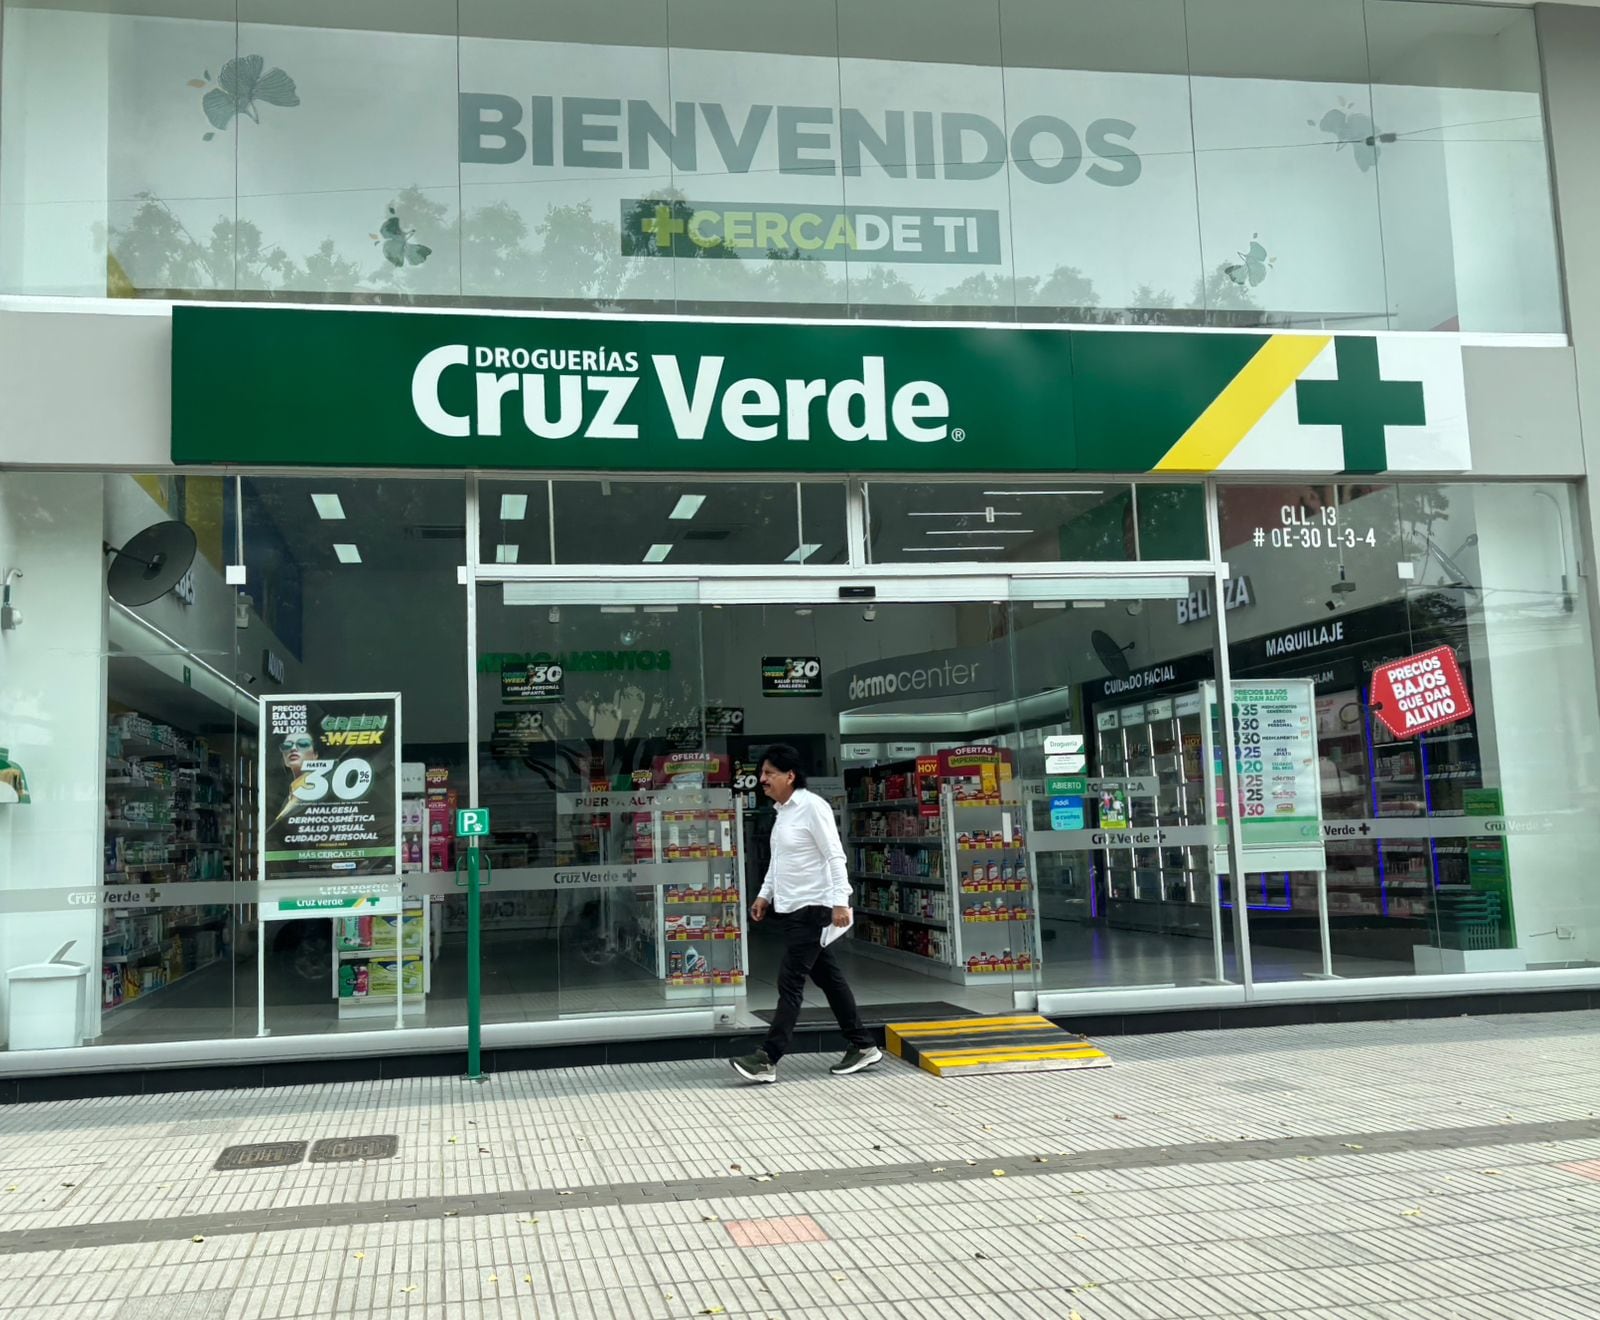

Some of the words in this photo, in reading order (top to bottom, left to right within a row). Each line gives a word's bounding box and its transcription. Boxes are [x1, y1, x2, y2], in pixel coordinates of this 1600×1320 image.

[458, 92, 1142, 187] BIENVENIDOS
[933, 216, 979, 253] TI
[475, 346, 639, 372] DROGUERÍAS
[411, 344, 640, 439] Cruz
[1281, 505, 1315, 526] CLL.
[1320, 506, 1337, 526] 13
[1266, 621, 1344, 657] MAQUILLAJE
[534, 665, 563, 684] 30
[792, 660, 820, 678] 30
[1387, 656, 1441, 683] PRECIOS
[849, 660, 979, 700] dermocenter
[1104, 673, 1143, 695] CUIDADO
[1144, 665, 1175, 687] FACIAL
[1391, 669, 1446, 700] BAJOS
[1398, 695, 1424, 711] QUE
[1425, 685, 1451, 703] DAN
[272, 712, 307, 720] BAJOS
[1241, 704, 1259, 716] 35
[1405, 698, 1456, 728] ALIVIO
[320, 714, 388, 731] GREEN
[1241, 718, 1259, 731] 30
[272, 726, 307, 734] ALIVIO
[325, 731, 385, 746] WEEK
[1242, 732, 1261, 745] 30
[672, 753, 710, 761] OFERTAS
[955, 747, 993, 756] OFERTAS
[1243, 746, 1262, 759] 25
[917, 764, 938, 773] HOY
[1243, 760, 1263, 773] 20
[292, 758, 373, 801] 30
[733, 774, 758, 789] 30
[1052, 782, 1082, 790] ABIERTO
[1245, 775, 1263, 787] 25
[1246, 789, 1264, 801] 25
[305, 806, 359, 815] ANALGESIA
[1246, 803, 1265, 816] 30
[288, 814, 376, 824] DERMOCOSMÉTICA
[463, 812, 478, 832] P
[298, 825, 330, 833] SALUD
[332, 824, 366, 832] VISUAL
[1323, 824, 1356, 836] Verde
[284, 834, 328, 843] CUIDADO
[329, 832, 379, 842] PERSONAL
[317, 851, 344, 859] CERCA
[553, 872, 581, 884] Cruz
[582, 871, 619, 883] Verde
[67, 892, 97, 905] Cruz
